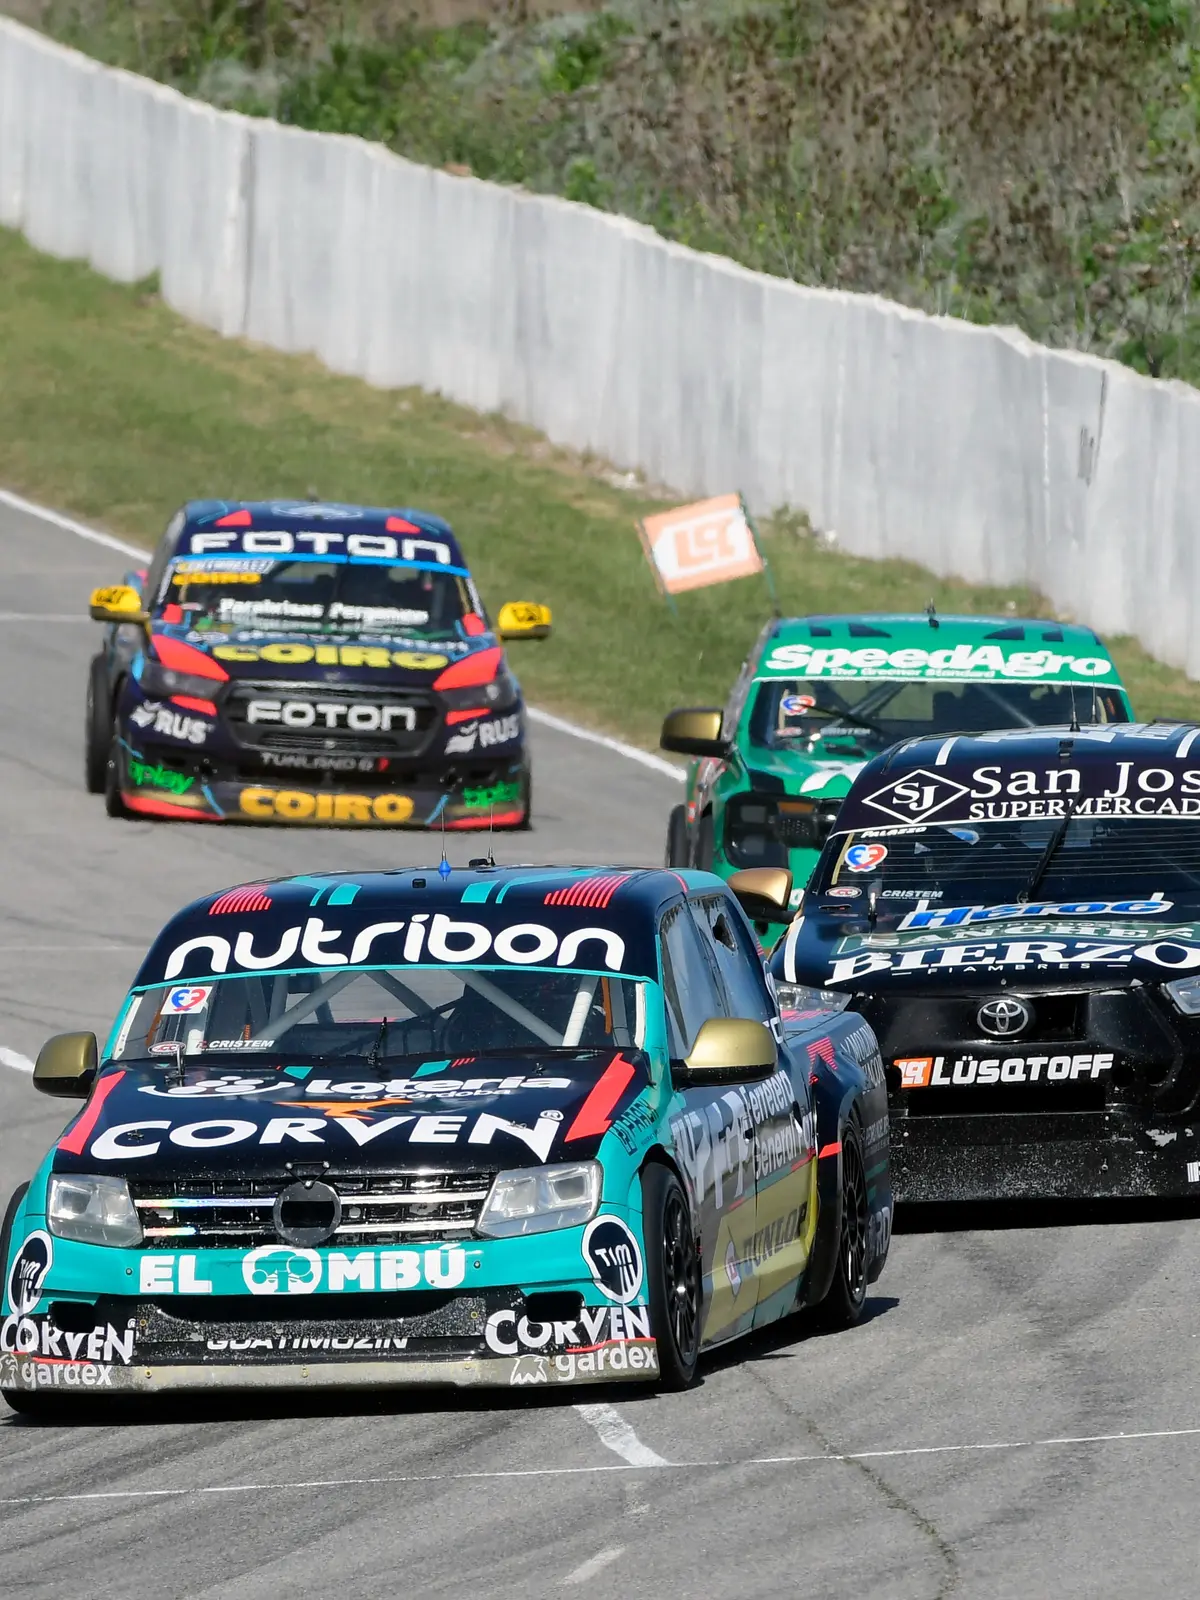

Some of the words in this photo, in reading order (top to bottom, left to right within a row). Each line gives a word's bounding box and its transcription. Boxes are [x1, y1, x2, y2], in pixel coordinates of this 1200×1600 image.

[212, 643, 449, 670] COIRO
[766, 644, 1112, 677] SpeedAgro
[154, 708, 206, 744] RUS
[479, 714, 520, 748] RUS
[892, 782, 940, 811] SJ
[970, 766, 1081, 799] San
[239, 787, 415, 822] COIRO
[882, 889, 944, 898] CRISTEM
[164, 914, 626, 979] nutribon
[824, 941, 1200, 985] BIERZO
[927, 963, 1090, 975] FIAMBRES
[209, 1040, 275, 1048] CRISTEM
[90, 1112, 560, 1164] CORVEN
[139, 1255, 212, 1293] EL
[551, 1341, 657, 1382] gardex
